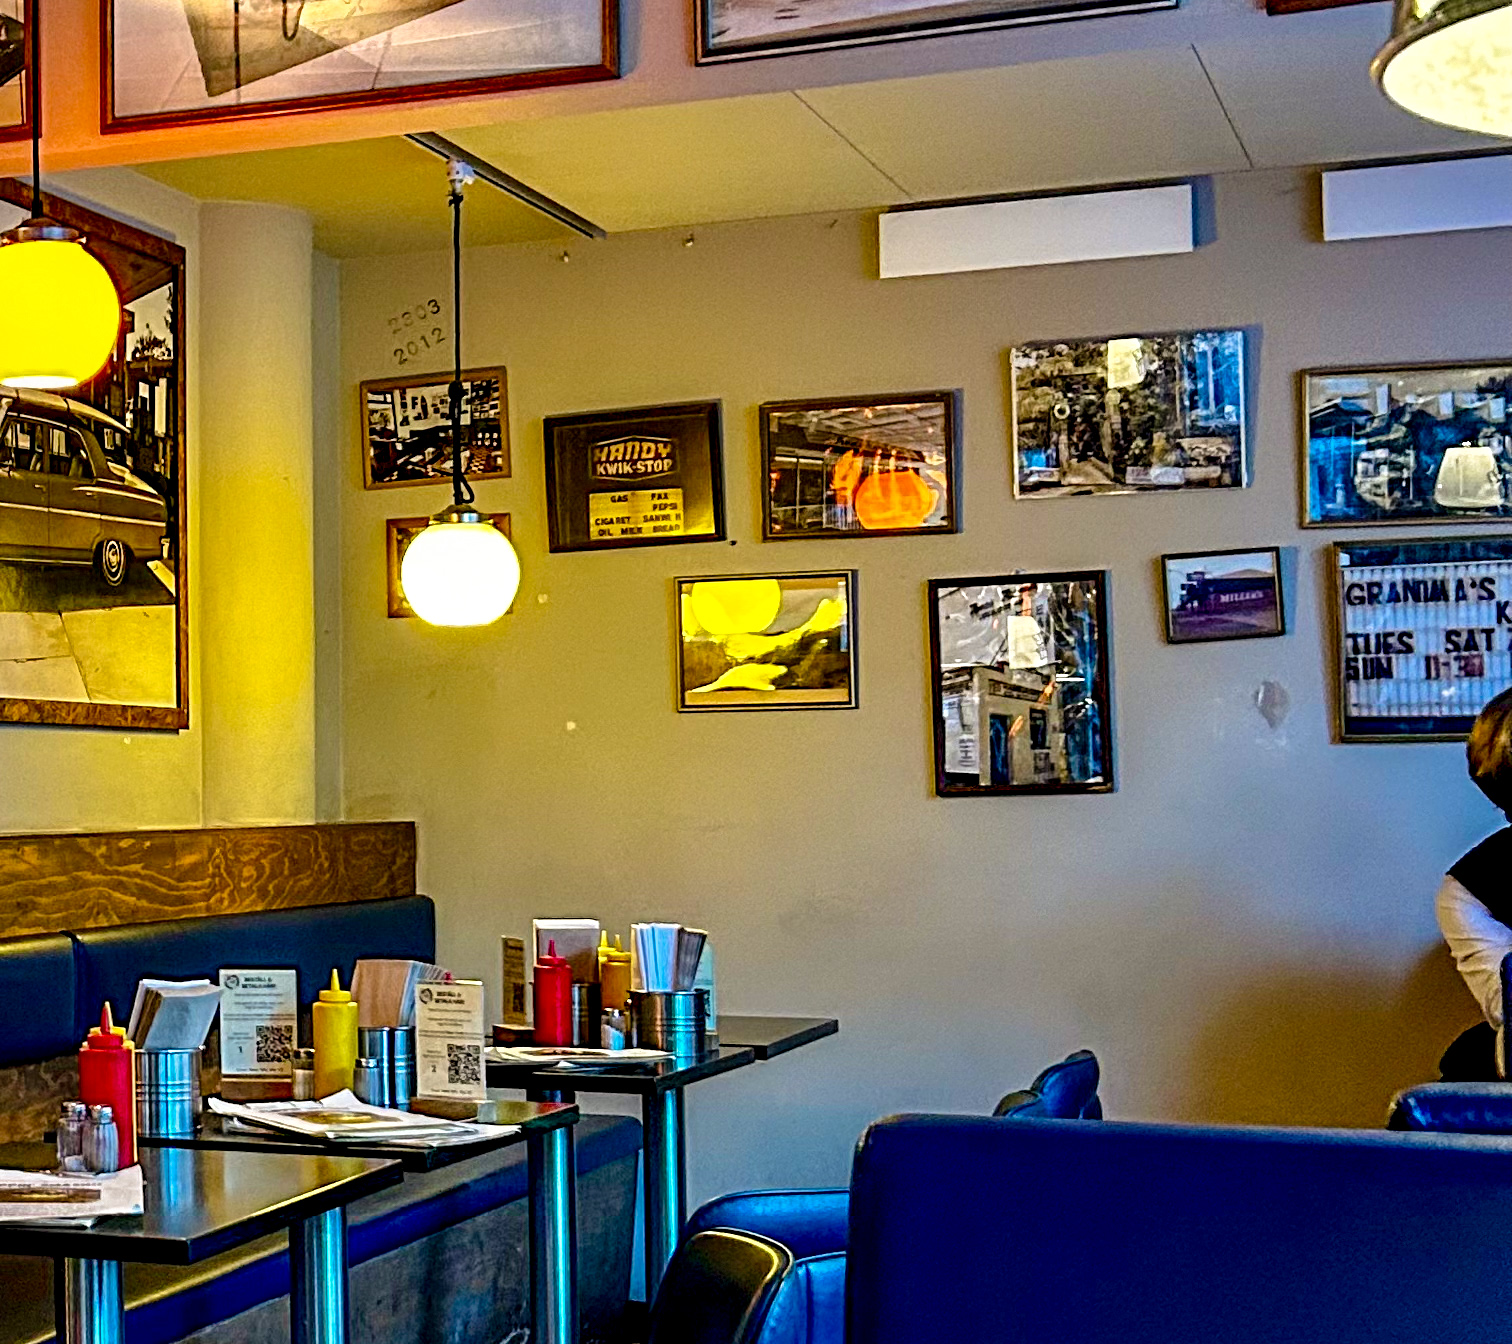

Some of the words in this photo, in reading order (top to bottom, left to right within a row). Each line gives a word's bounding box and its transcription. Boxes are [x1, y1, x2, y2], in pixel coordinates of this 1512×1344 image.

[593, 441, 672, 462] HANDY
[596, 458, 673, 476] KWIK-STOP
[610, 494, 629, 504] GAS
[1345, 630, 1415, 656] TUES
[1444, 628, 1496, 654] SAT
[1345, 656, 1394, 682] SUN
